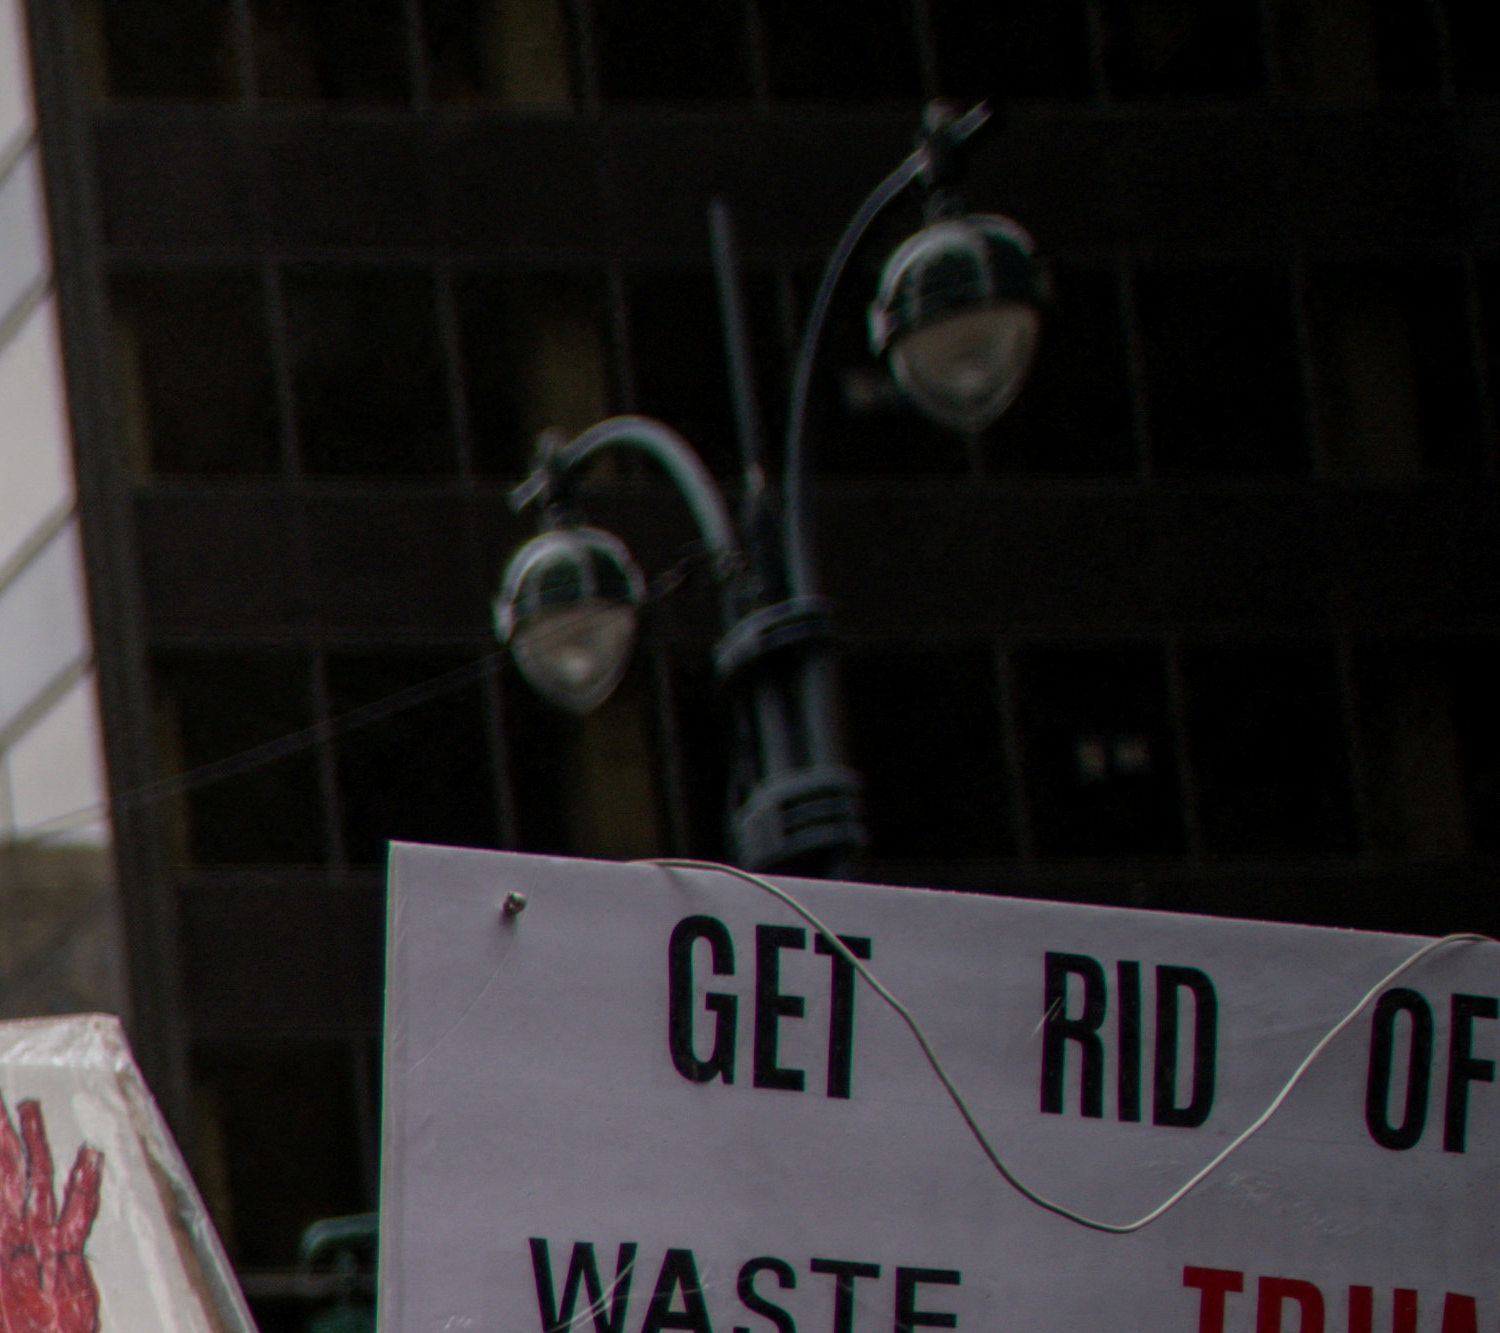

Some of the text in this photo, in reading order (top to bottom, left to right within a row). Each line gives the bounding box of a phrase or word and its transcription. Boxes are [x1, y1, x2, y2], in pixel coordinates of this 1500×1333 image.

[667, 915, 1500, 1154] GET RID OF
